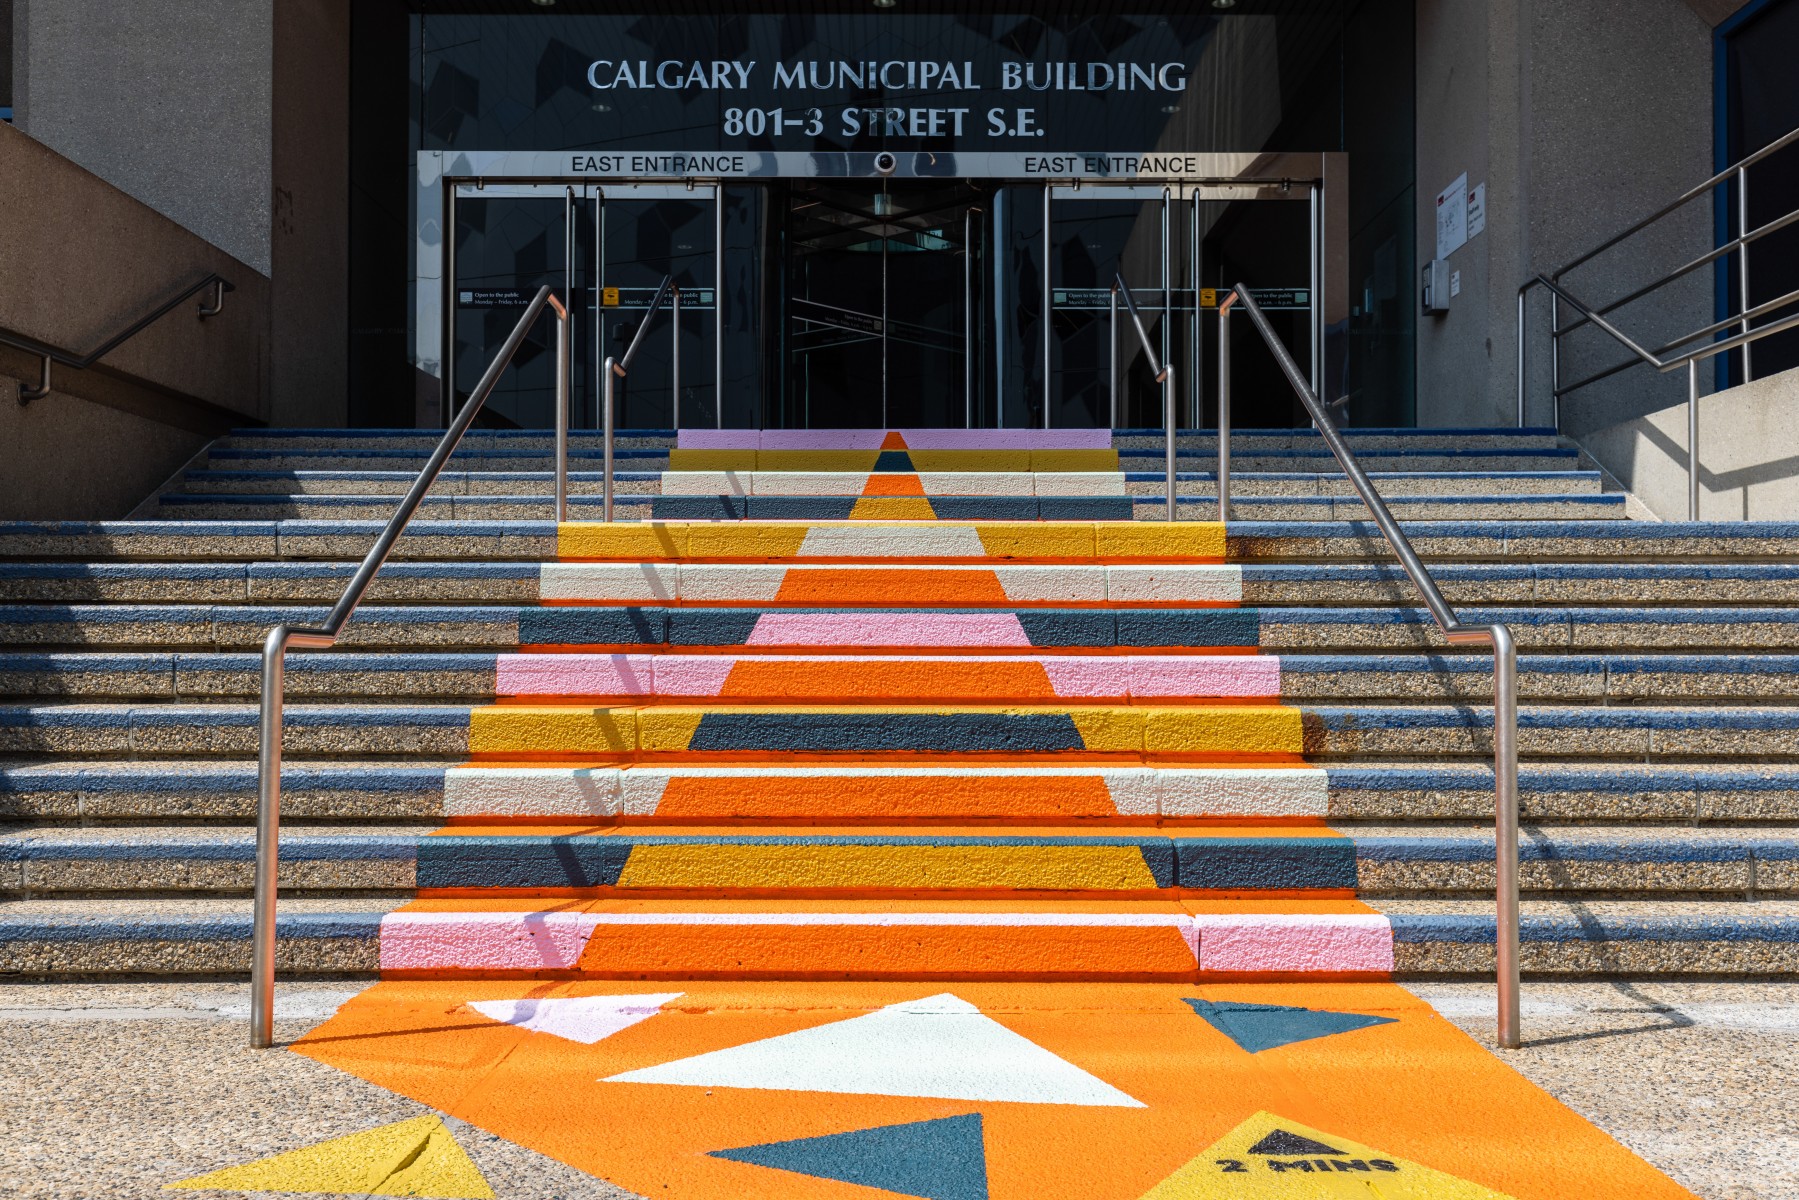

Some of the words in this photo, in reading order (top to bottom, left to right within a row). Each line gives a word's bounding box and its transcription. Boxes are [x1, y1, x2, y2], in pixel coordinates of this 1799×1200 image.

[587, 60, 756, 90] CALGARY
[772, 60, 981, 91] MUNICIPAL
[1001, 60, 1186, 91] BUILDING
[840, 107, 970, 137] STREET
[987, 107, 1045, 137] S.E.
[571, 156, 625, 174] EAST
[631, 156, 744, 174] ENTRANCE
[1024, 157, 1078, 174] EAST
[1084, 157, 1197, 174] ENTRANCE
[504, 291, 519, 299] public
[683, 291, 699, 299] public
[1215, 1159, 1248, 1172] 2
[1267, 1159, 1401, 1173] MINS
